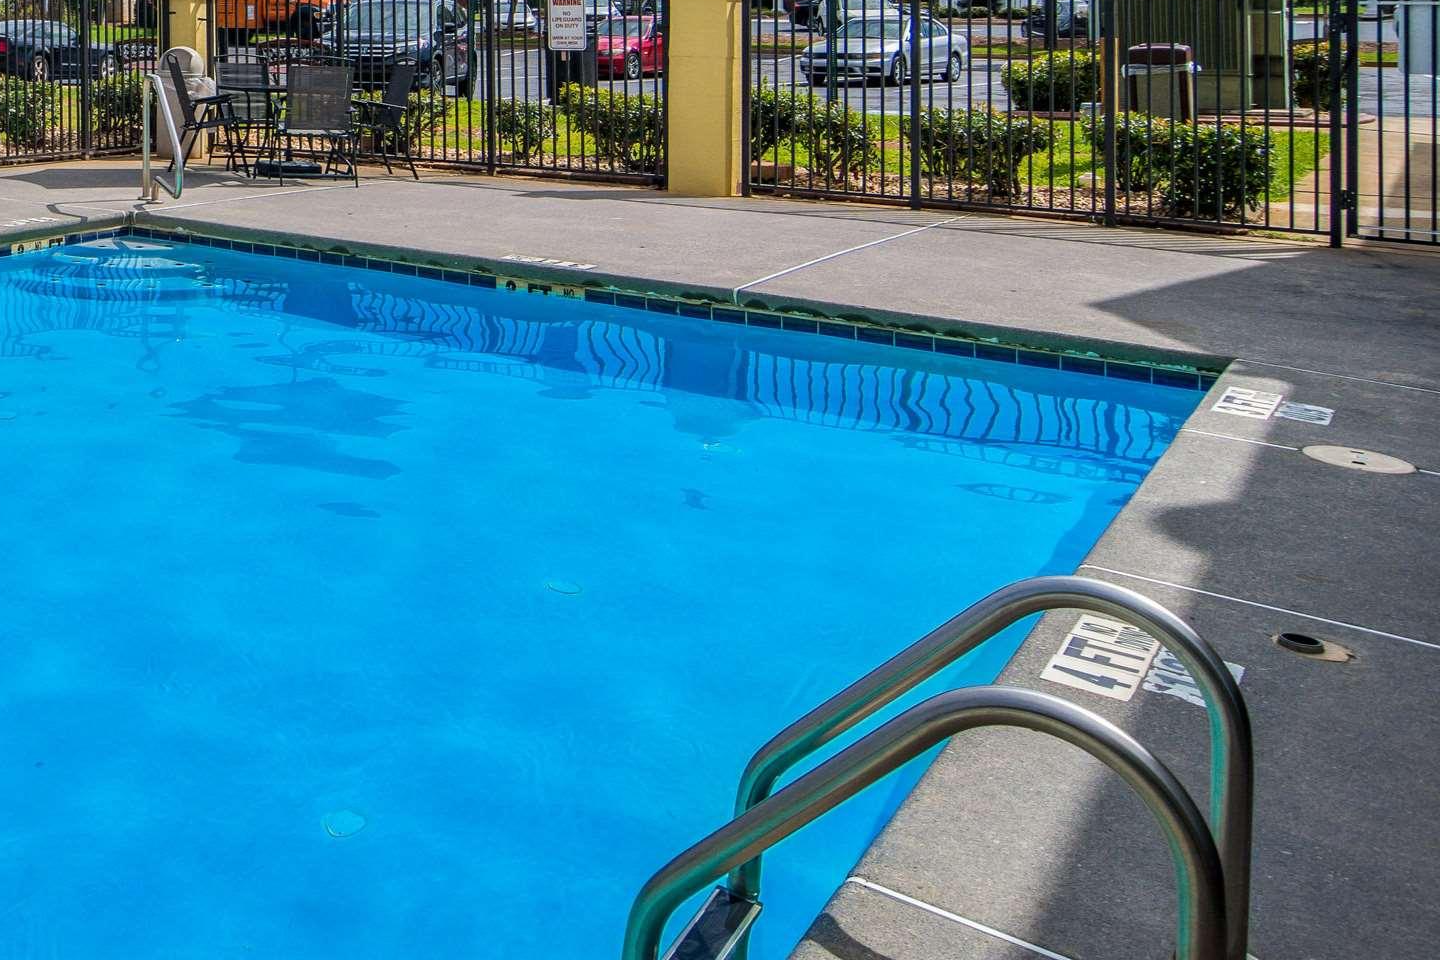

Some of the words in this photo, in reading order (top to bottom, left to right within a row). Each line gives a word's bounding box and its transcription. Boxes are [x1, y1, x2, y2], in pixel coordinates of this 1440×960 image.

[1080, 622, 1119, 637] NO
[1063, 636, 1145, 673] FT
[1052, 664, 1132, 689] 4
